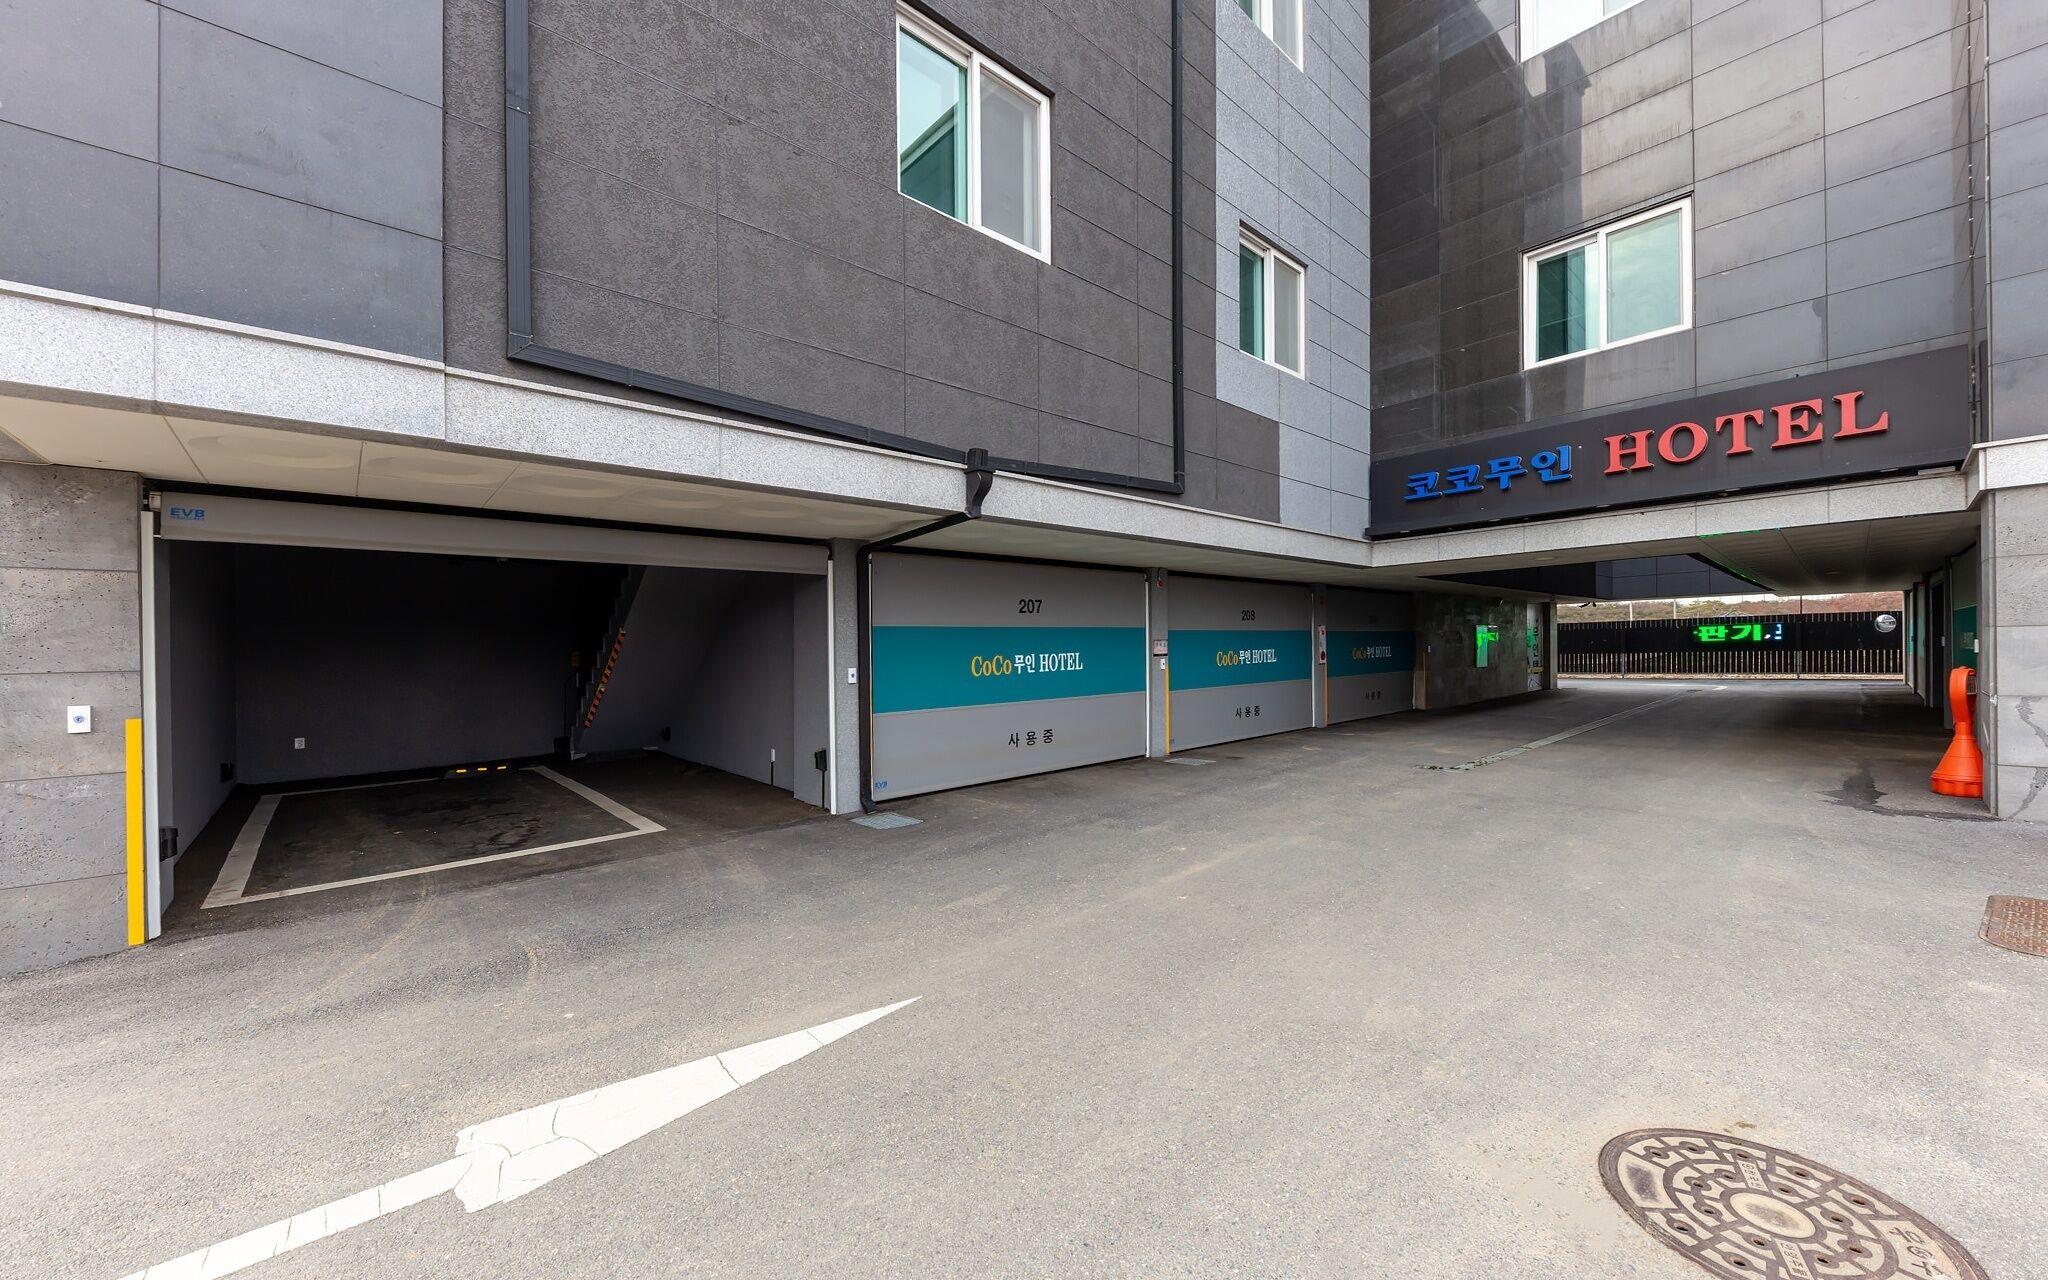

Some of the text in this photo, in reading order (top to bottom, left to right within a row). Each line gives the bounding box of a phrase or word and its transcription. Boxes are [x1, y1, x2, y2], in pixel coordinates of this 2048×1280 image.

[1402, 390, 1890, 502] 코코무인 HOTEL
[170, 507, 205, 518] EVB
[1018, 599, 1043, 614] 207
[1241, 610, 1256, 621] 208
[971, 652, 1084, 677] CoCo 무인 HOTEL
[1216, 651, 1239, 667] CoCo
[1252, 648, 1277, 664] HOTEL
